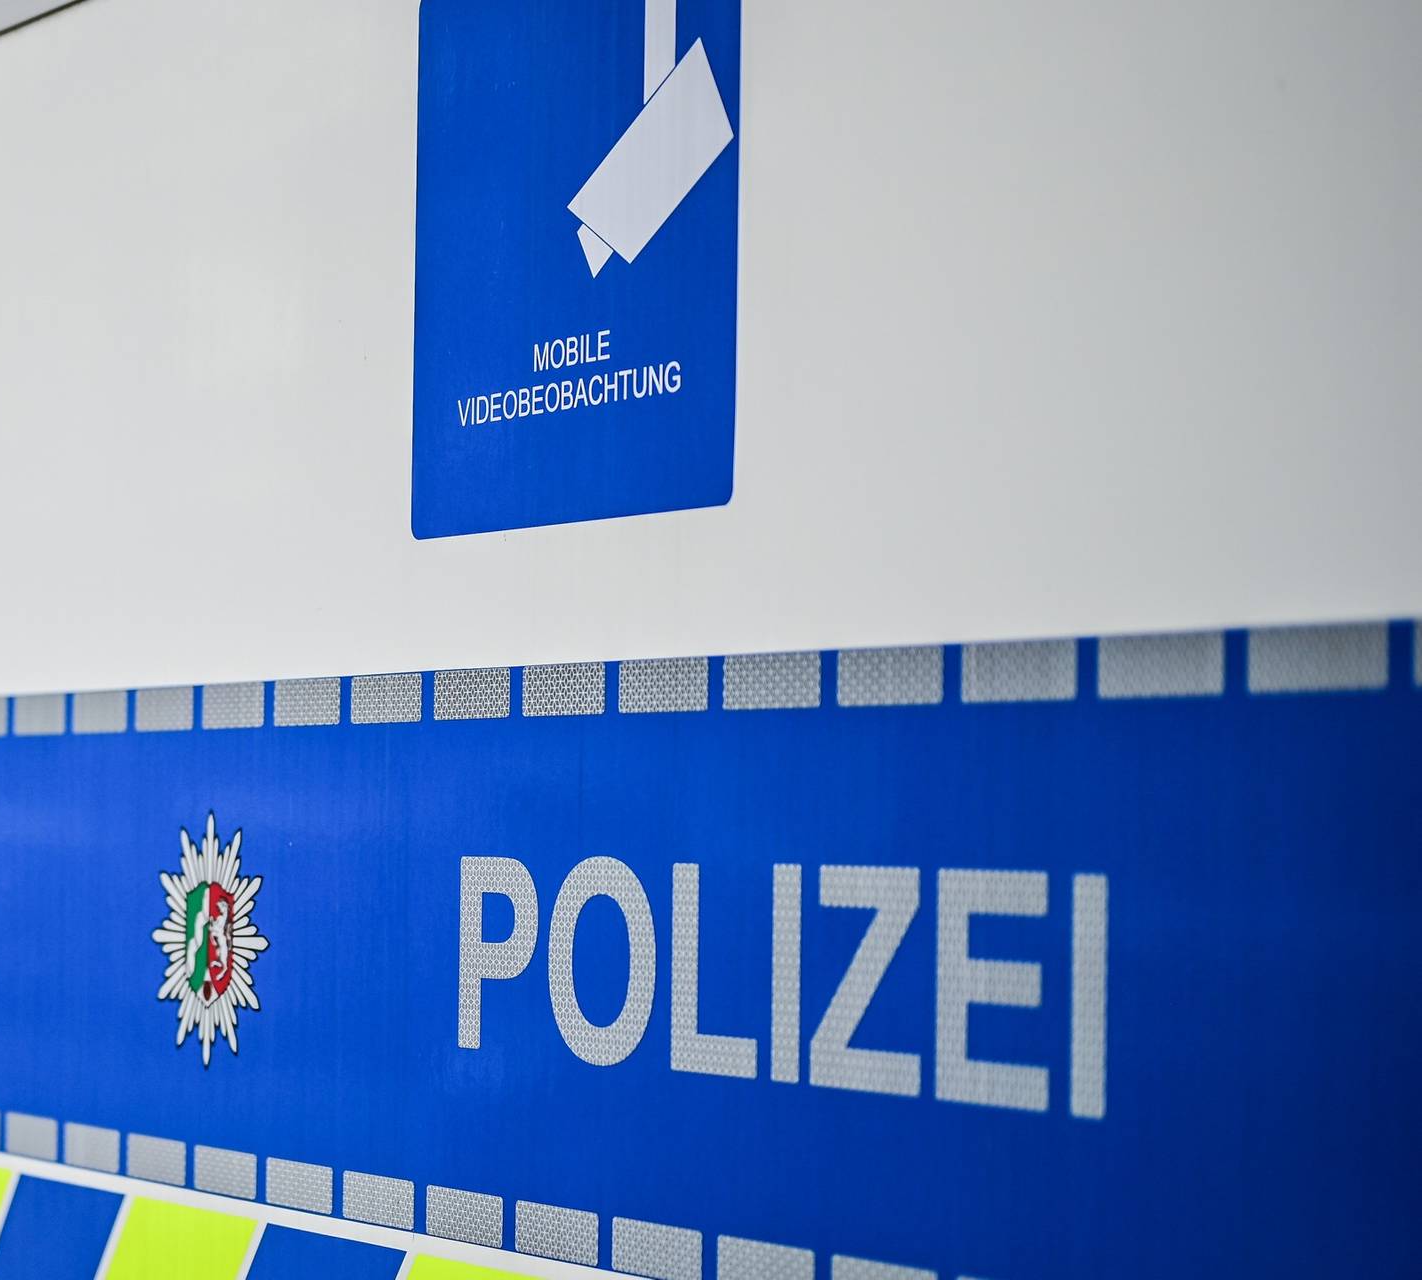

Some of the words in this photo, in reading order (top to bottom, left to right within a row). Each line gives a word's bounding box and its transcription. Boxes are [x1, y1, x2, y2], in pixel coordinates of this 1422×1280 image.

[533, 329, 611, 372] MOBILE
[457, 360, 682, 427] VIDEOBEOBACHTUNG
[457, 855, 1109, 1119] POLIZEI
